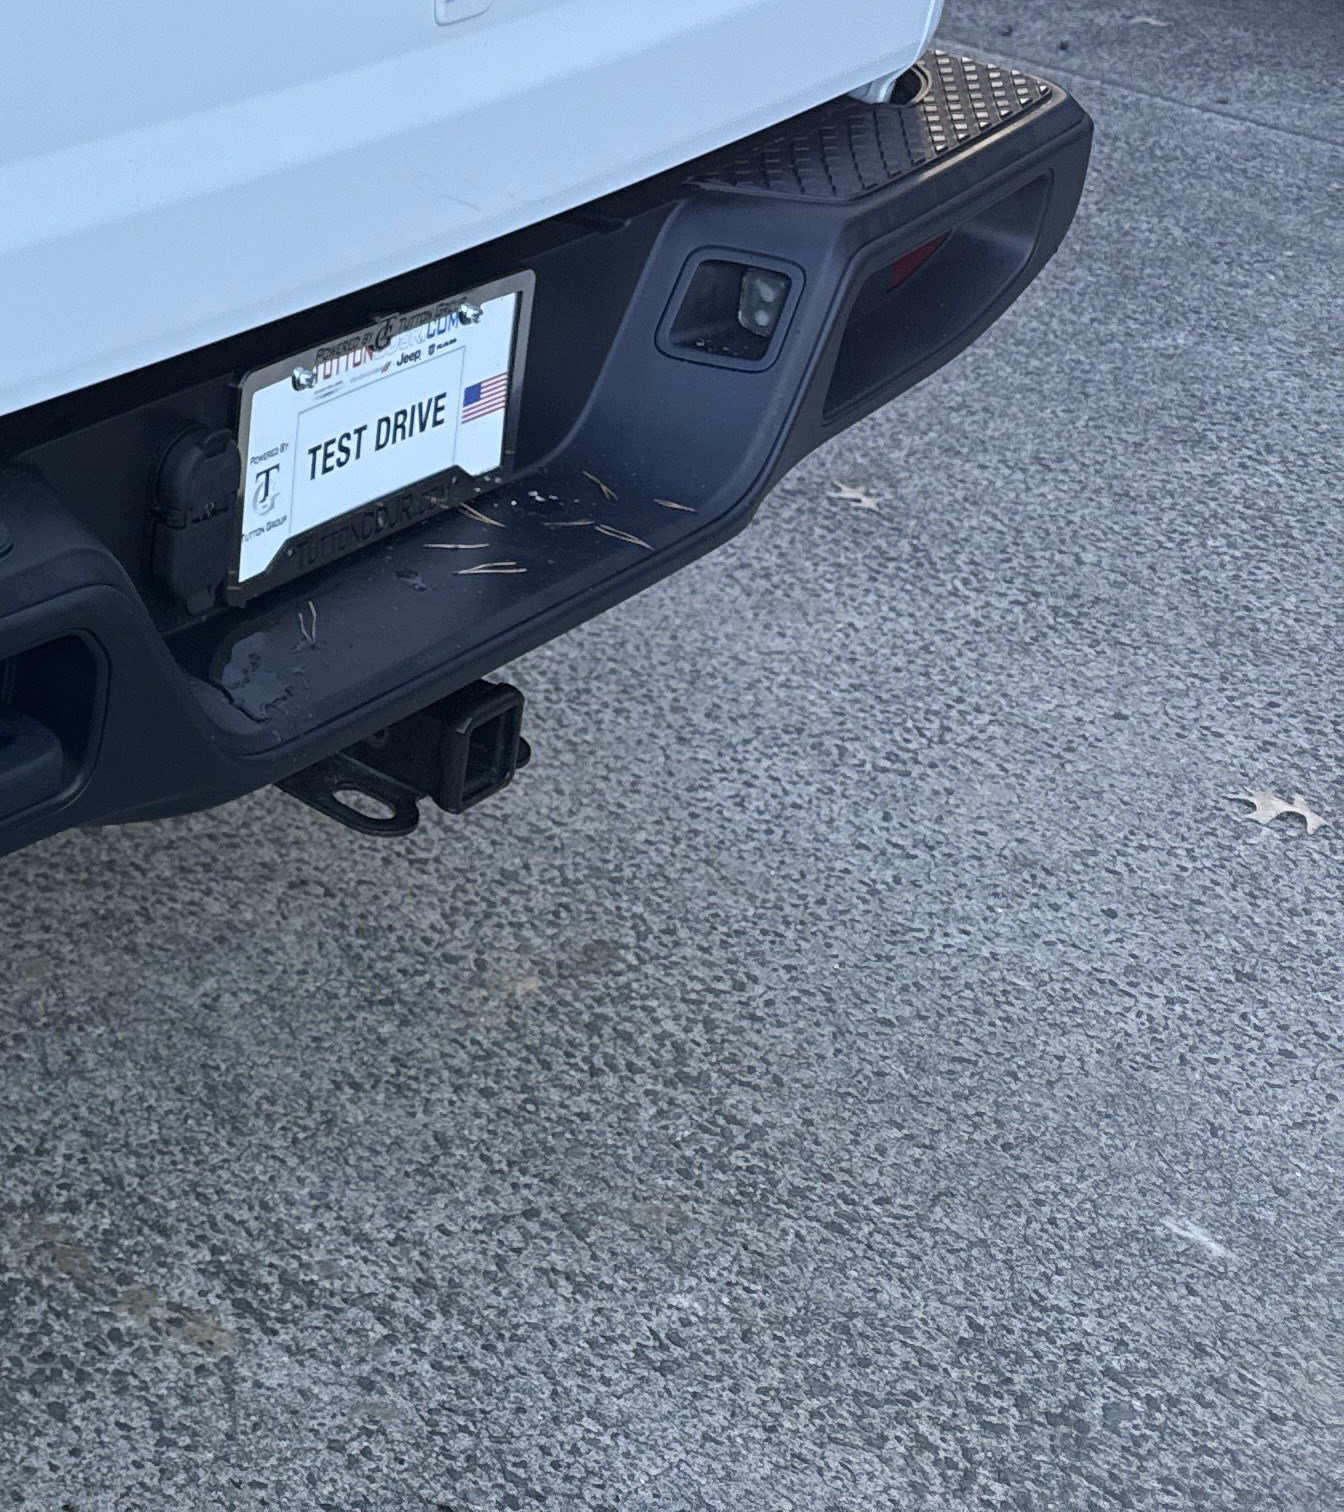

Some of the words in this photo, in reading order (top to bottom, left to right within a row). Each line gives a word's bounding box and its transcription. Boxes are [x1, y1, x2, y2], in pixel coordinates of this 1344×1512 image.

[396, 349, 421, 366] Jeep
[307, 424, 368, 481] TEST
[374, 392, 447, 451] DRIVE
